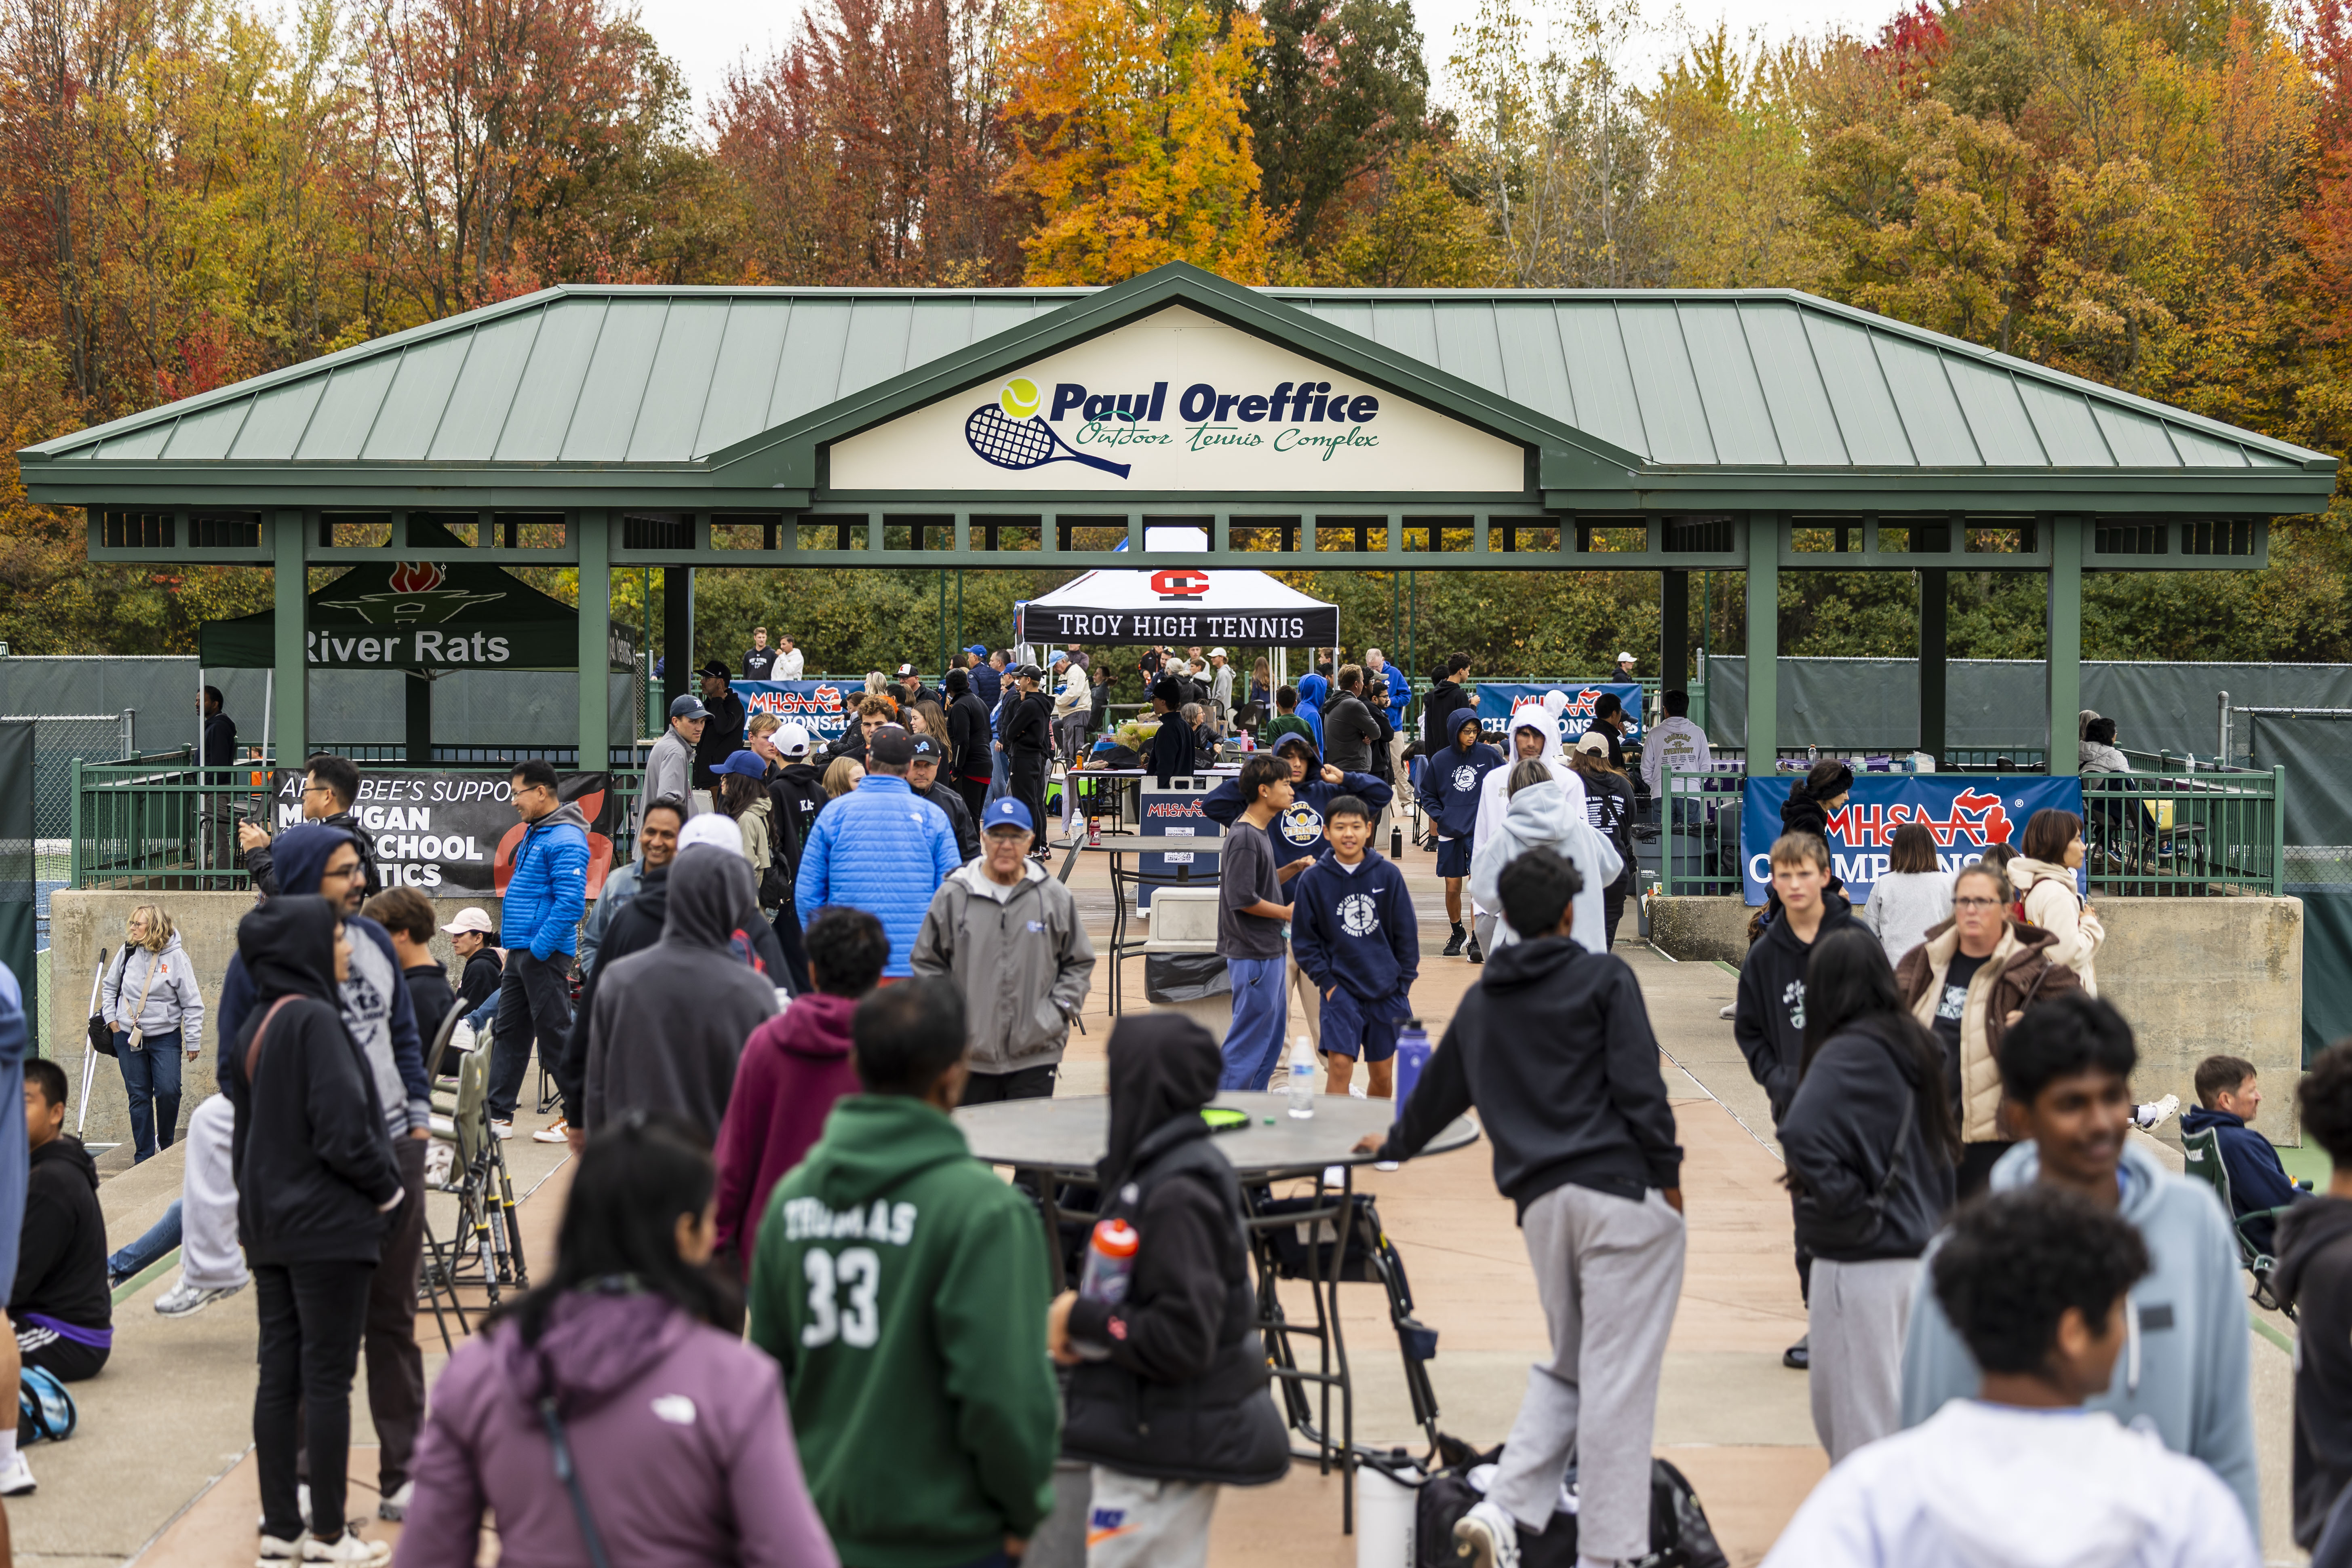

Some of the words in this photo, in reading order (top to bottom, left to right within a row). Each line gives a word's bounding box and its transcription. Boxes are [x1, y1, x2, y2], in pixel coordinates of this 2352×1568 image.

[1050, 381, 1168, 422] Paul
[1179, 381, 1379, 422] Oreffice
[1076, 410, 1173, 447] Outdoor
[1274, 426, 1379, 462] Complex
[1058, 614, 1123, 635] TROY
[1134, 616, 1197, 637] HIGH
[1207, 617, 1303, 638] TENNIS
[415, 631, 510, 662] Rats
[615, 629, 632, 665] Tennis
[748, 692, 831, 713] MHSAA
[1664, 733, 1691, 744] COUGARS
[1663, 747, 1694, 755] EVERYBODY
[1147, 803, 1203, 817] MHSAA
[1285, 826, 1320, 836] TENNIS
[1824, 803, 1986, 847] MHSAA
[161, 964, 168, 973] R
[801, 1247, 881, 1349] 33
